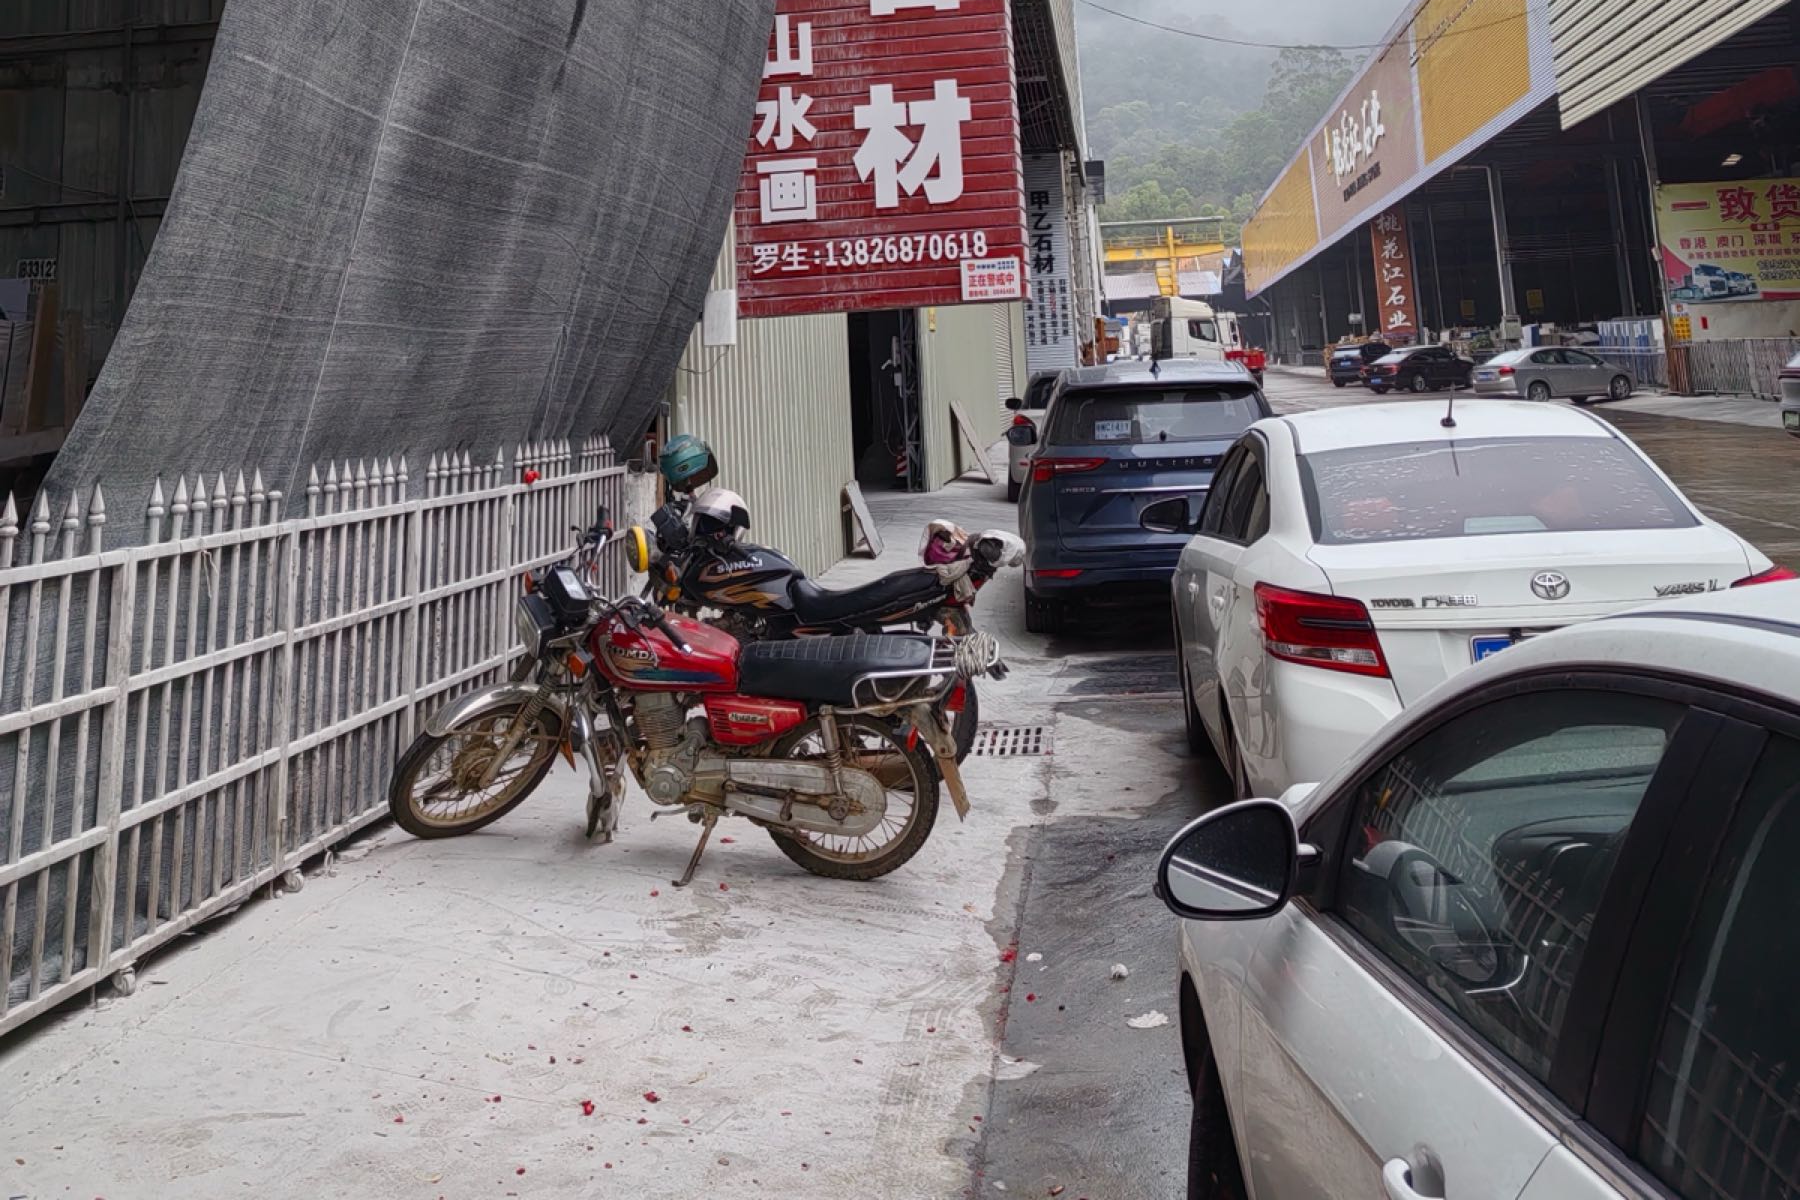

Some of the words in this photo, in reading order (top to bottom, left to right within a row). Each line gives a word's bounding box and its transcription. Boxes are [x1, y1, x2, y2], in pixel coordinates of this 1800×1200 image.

[1030, 190, 1055, 274] 甲乙石材
[1376, 213, 1412, 330] 桃花江石业
[1371, 598, 1414, 608] TOYOTA
[1653, 582, 1705, 597] YARIS
